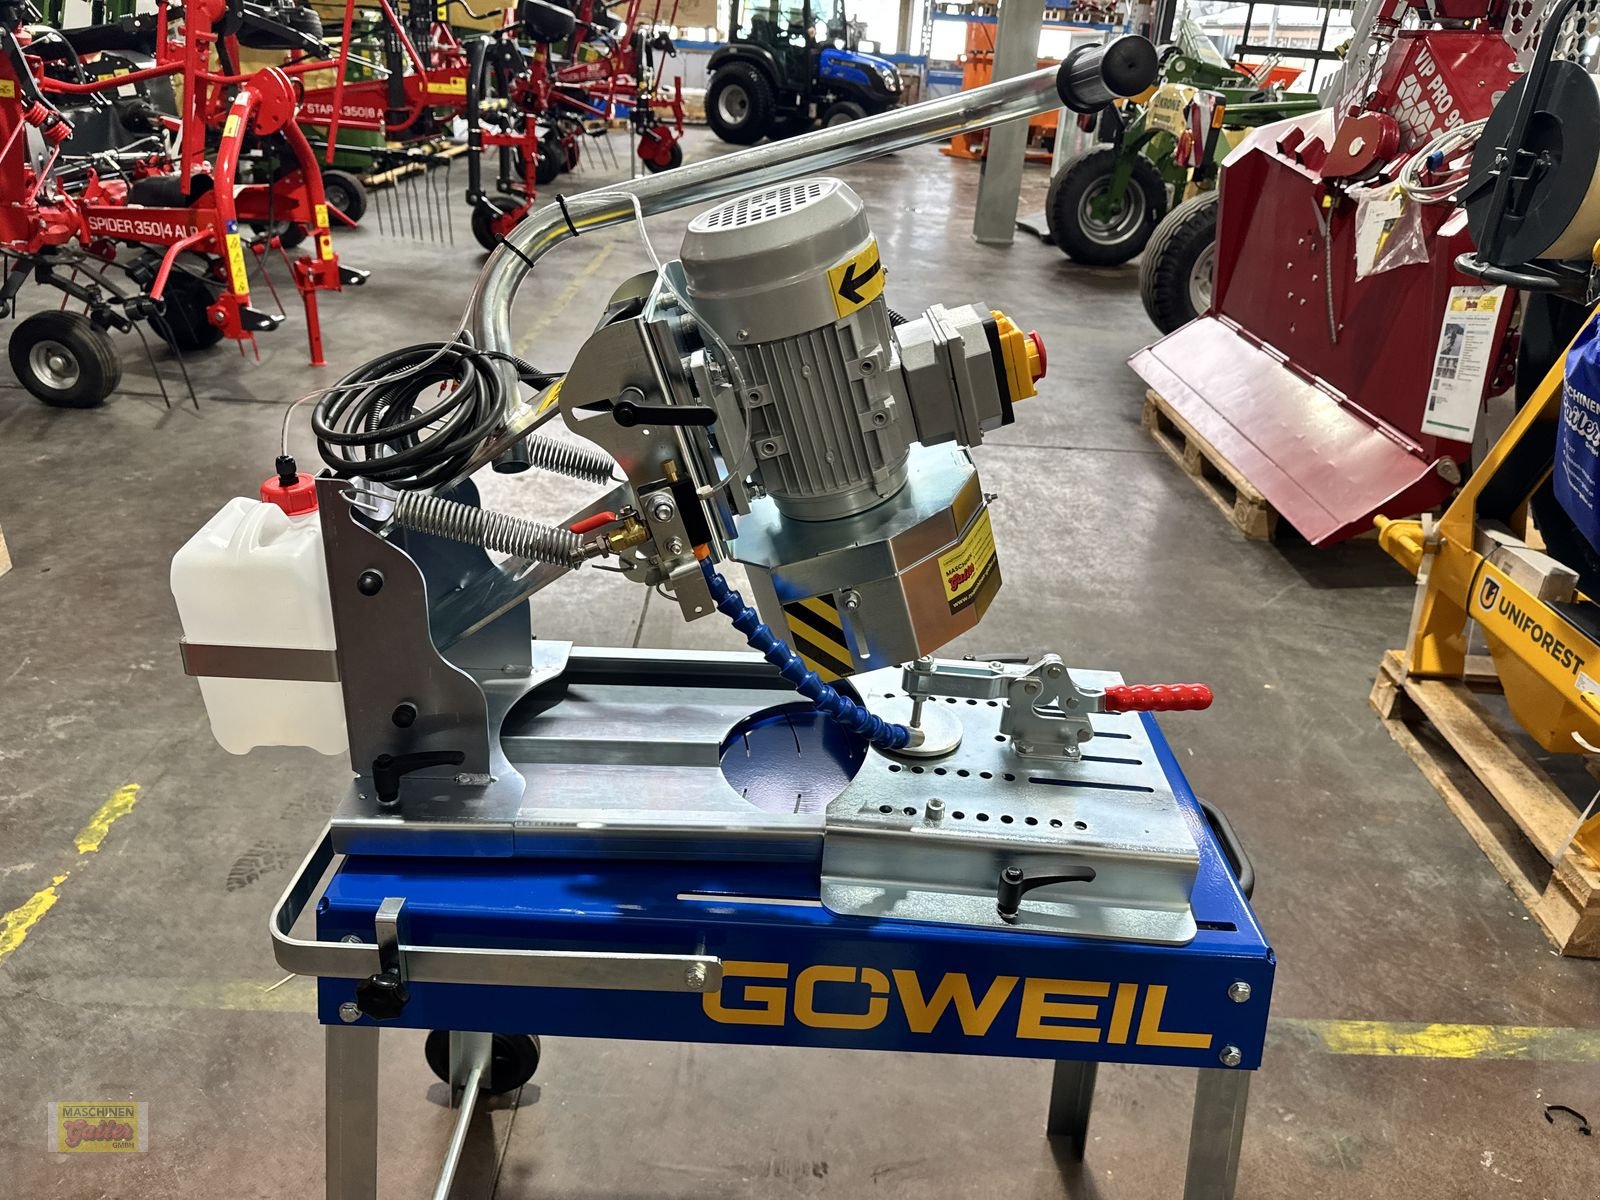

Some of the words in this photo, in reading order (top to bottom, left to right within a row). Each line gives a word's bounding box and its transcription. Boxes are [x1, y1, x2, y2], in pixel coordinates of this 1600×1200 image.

[1414, 46, 1436, 77] VIP
[1426, 74, 1453, 114] PRO
[88, 216, 134, 233] SPIDER
[1498, 596, 1585, 676] UNIFOREST
